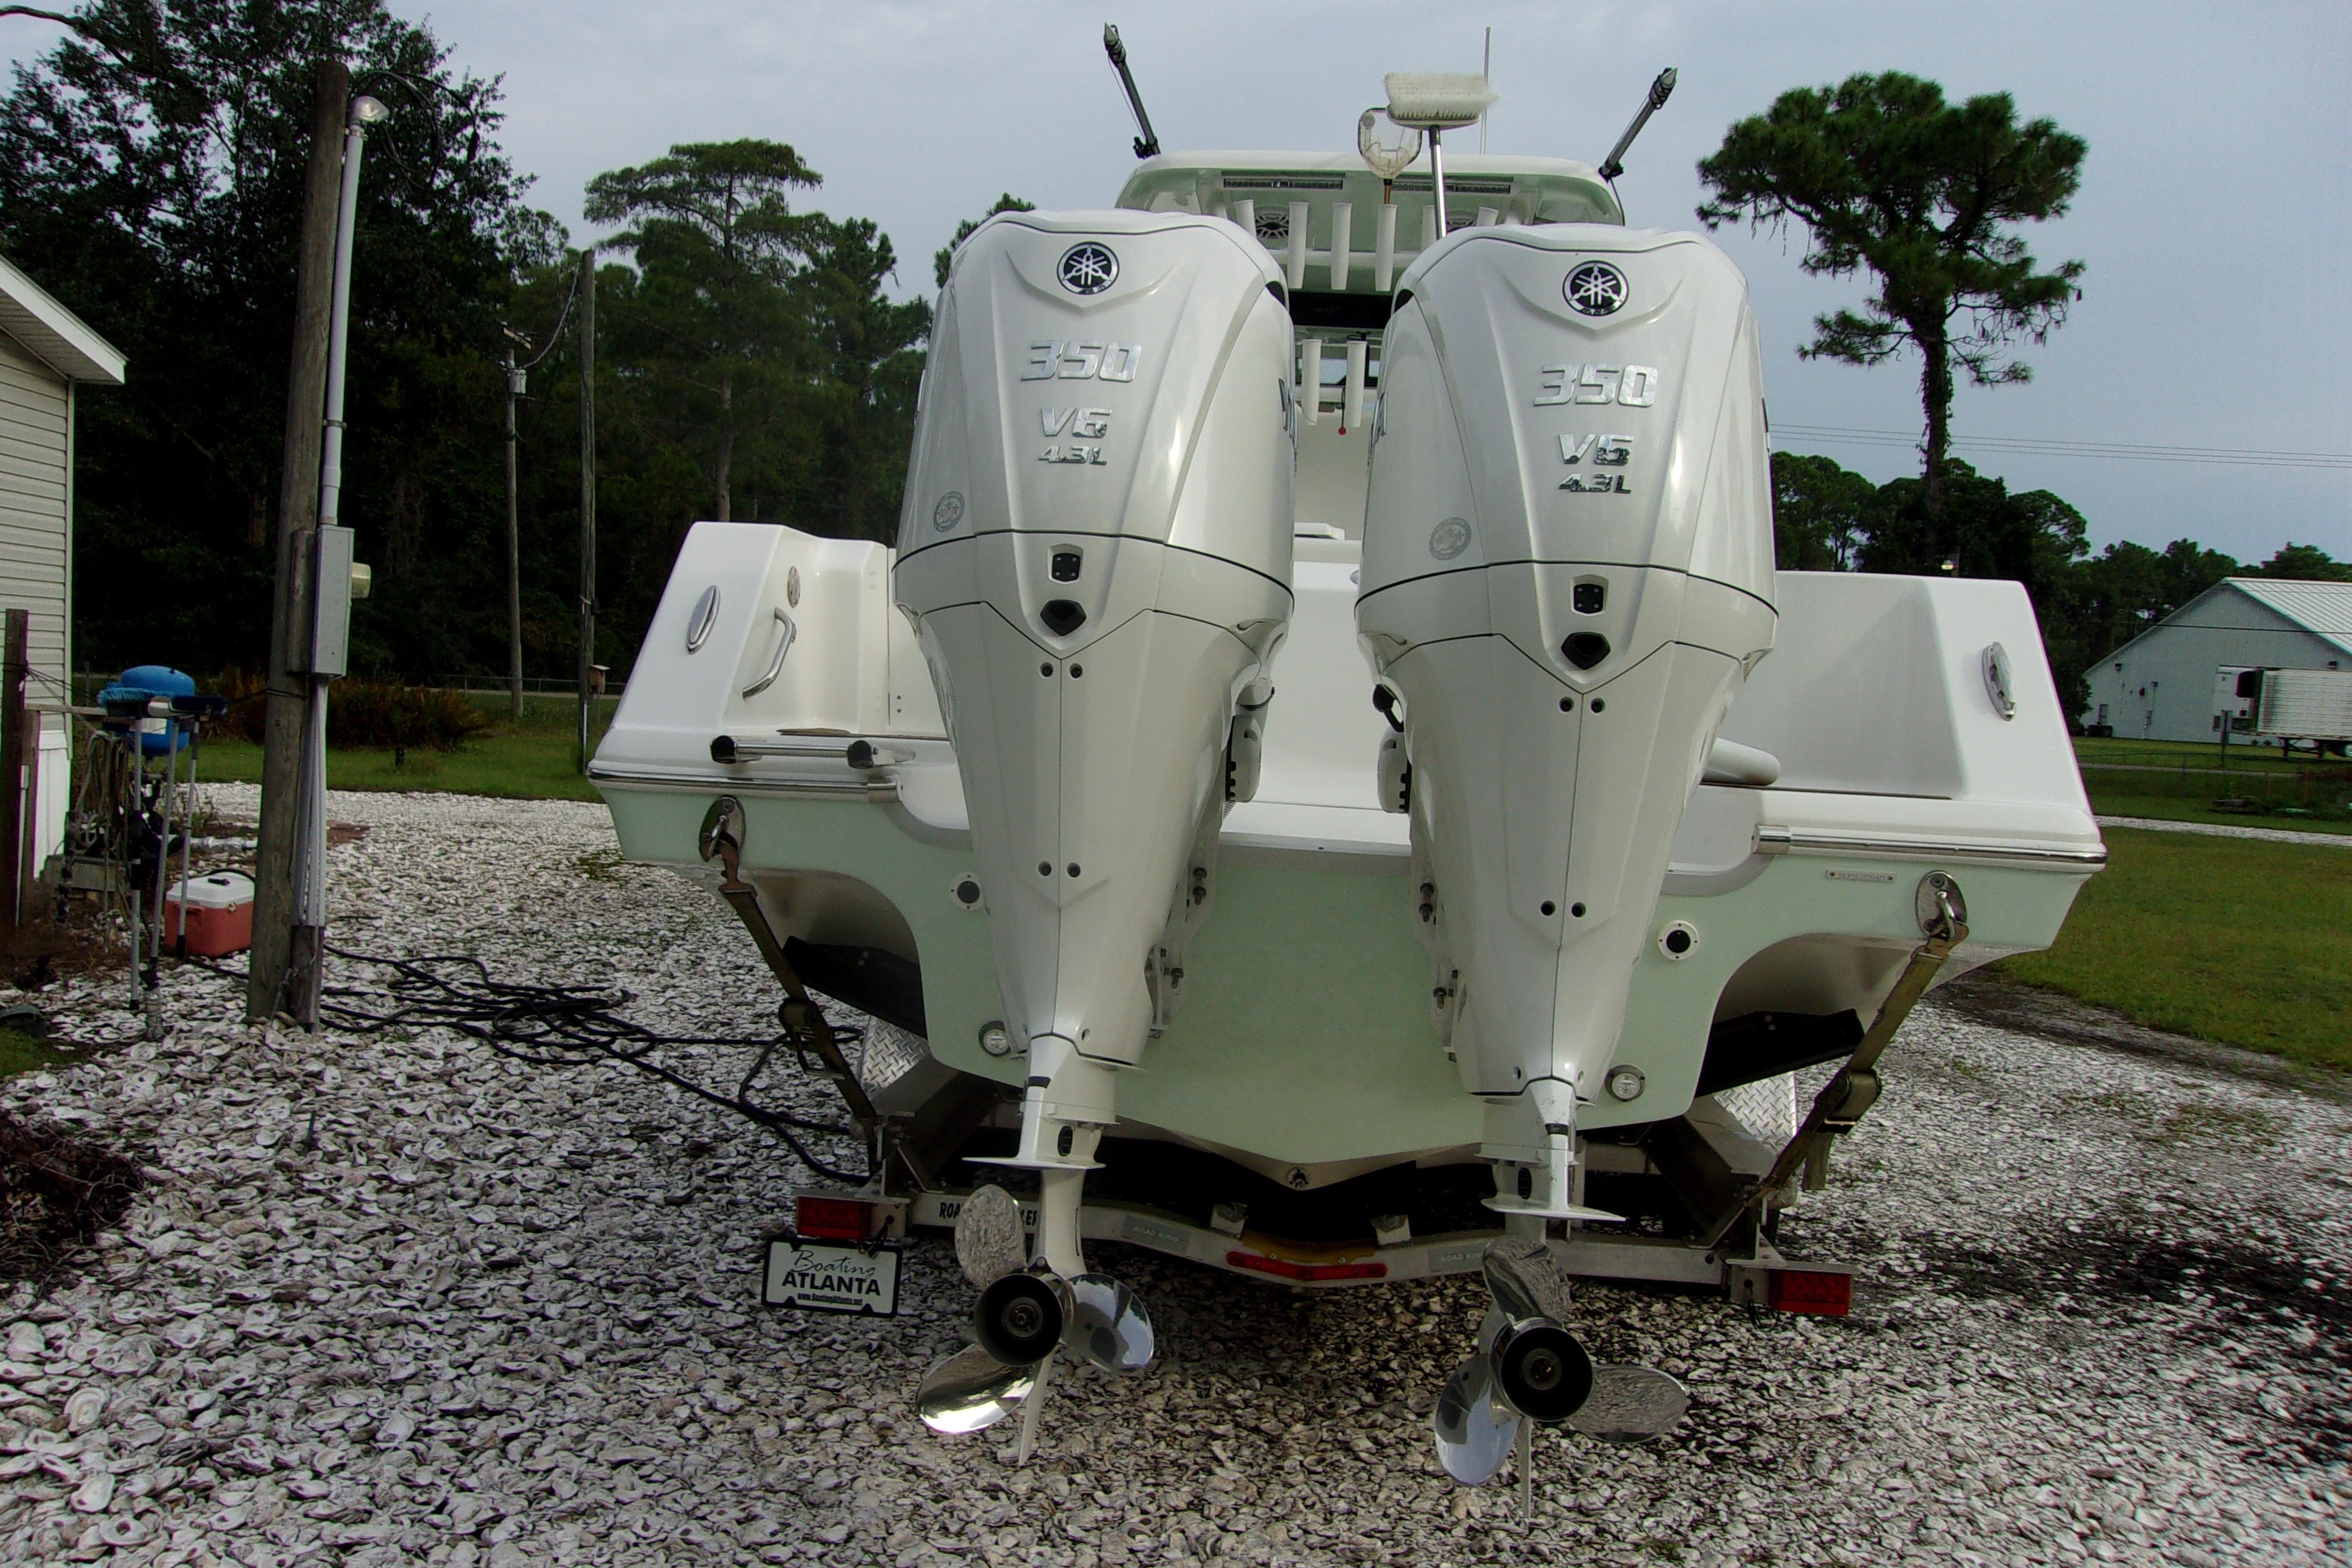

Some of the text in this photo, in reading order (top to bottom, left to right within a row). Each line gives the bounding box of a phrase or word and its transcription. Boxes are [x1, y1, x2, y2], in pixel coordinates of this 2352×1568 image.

[1021, 339, 1142, 383] 350
[1534, 363, 1658, 407] 350
[1040, 407, 1112, 437] V6
[1038, 445, 1107, 465] 4.3L
[1558, 433, 1633, 465] V6
[1558, 473, 1632, 494] 4.3L
[939, 1202, 961, 1219] ROA
[790, 1250, 876, 1277] Boating
[781, 1271, 880, 1296] ATLANTA
